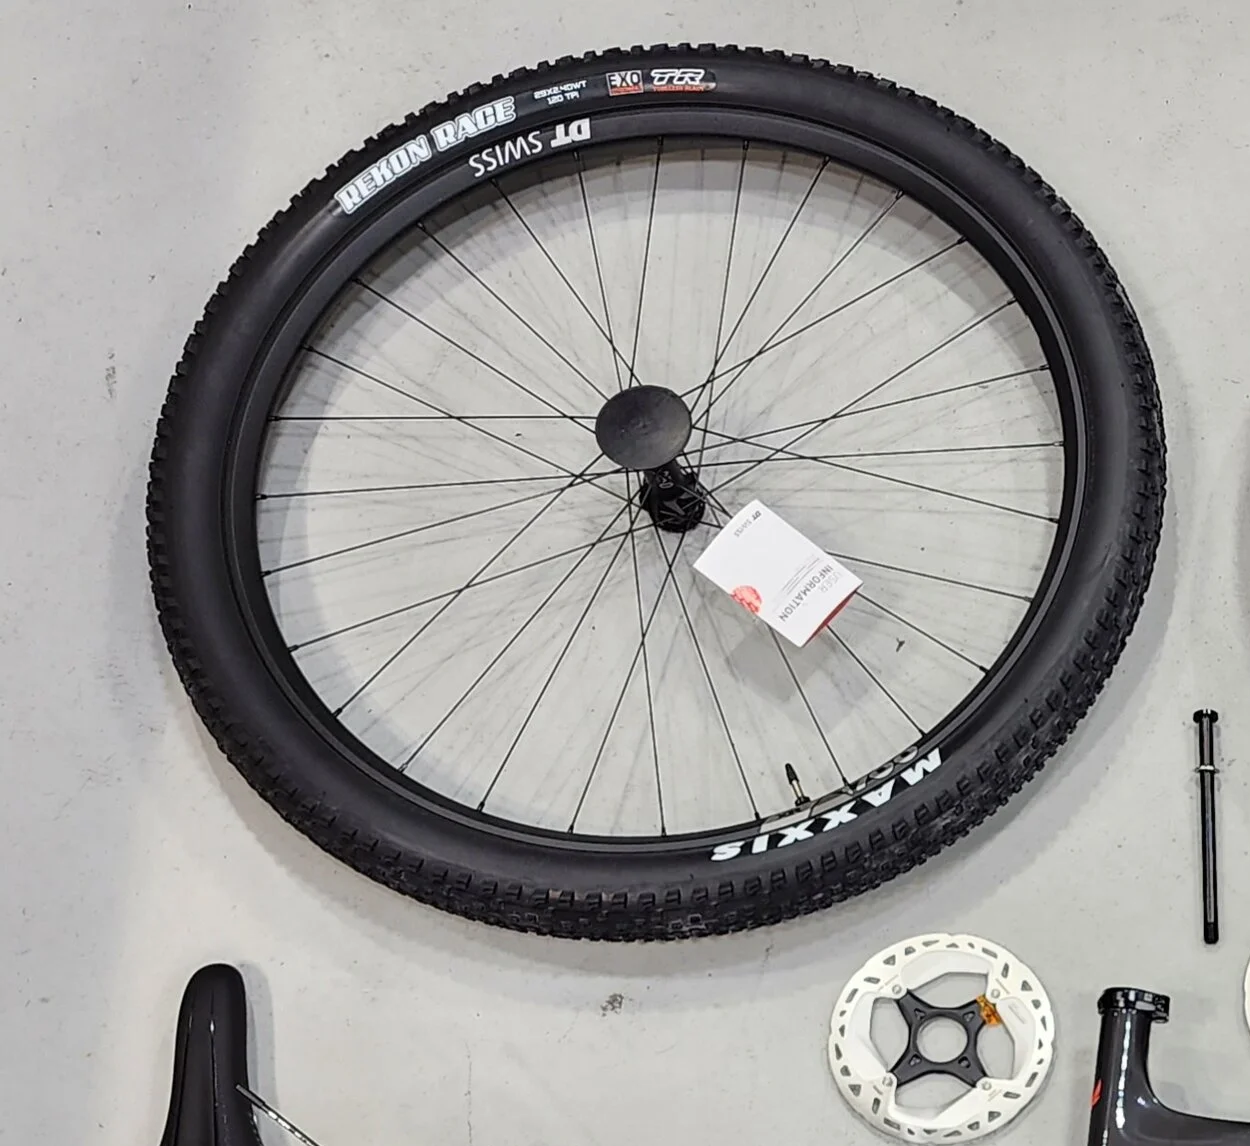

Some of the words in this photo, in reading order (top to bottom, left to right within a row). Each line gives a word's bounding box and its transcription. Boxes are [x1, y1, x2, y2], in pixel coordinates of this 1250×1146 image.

[608, 72, 642, 88] EXO
[651, 68, 705, 85] TR
[546, 93, 564, 105] 120
[566, 92, 580, 101] TPI
[468, 130, 542, 178] SWISS
[550, 118, 591, 150] DT
[334, 134, 433, 216] REKON
[430, 96, 517, 153] RACE
[778, 564, 834, 623] INFORMATION
[711, 747, 942, 862] MAXXIS
